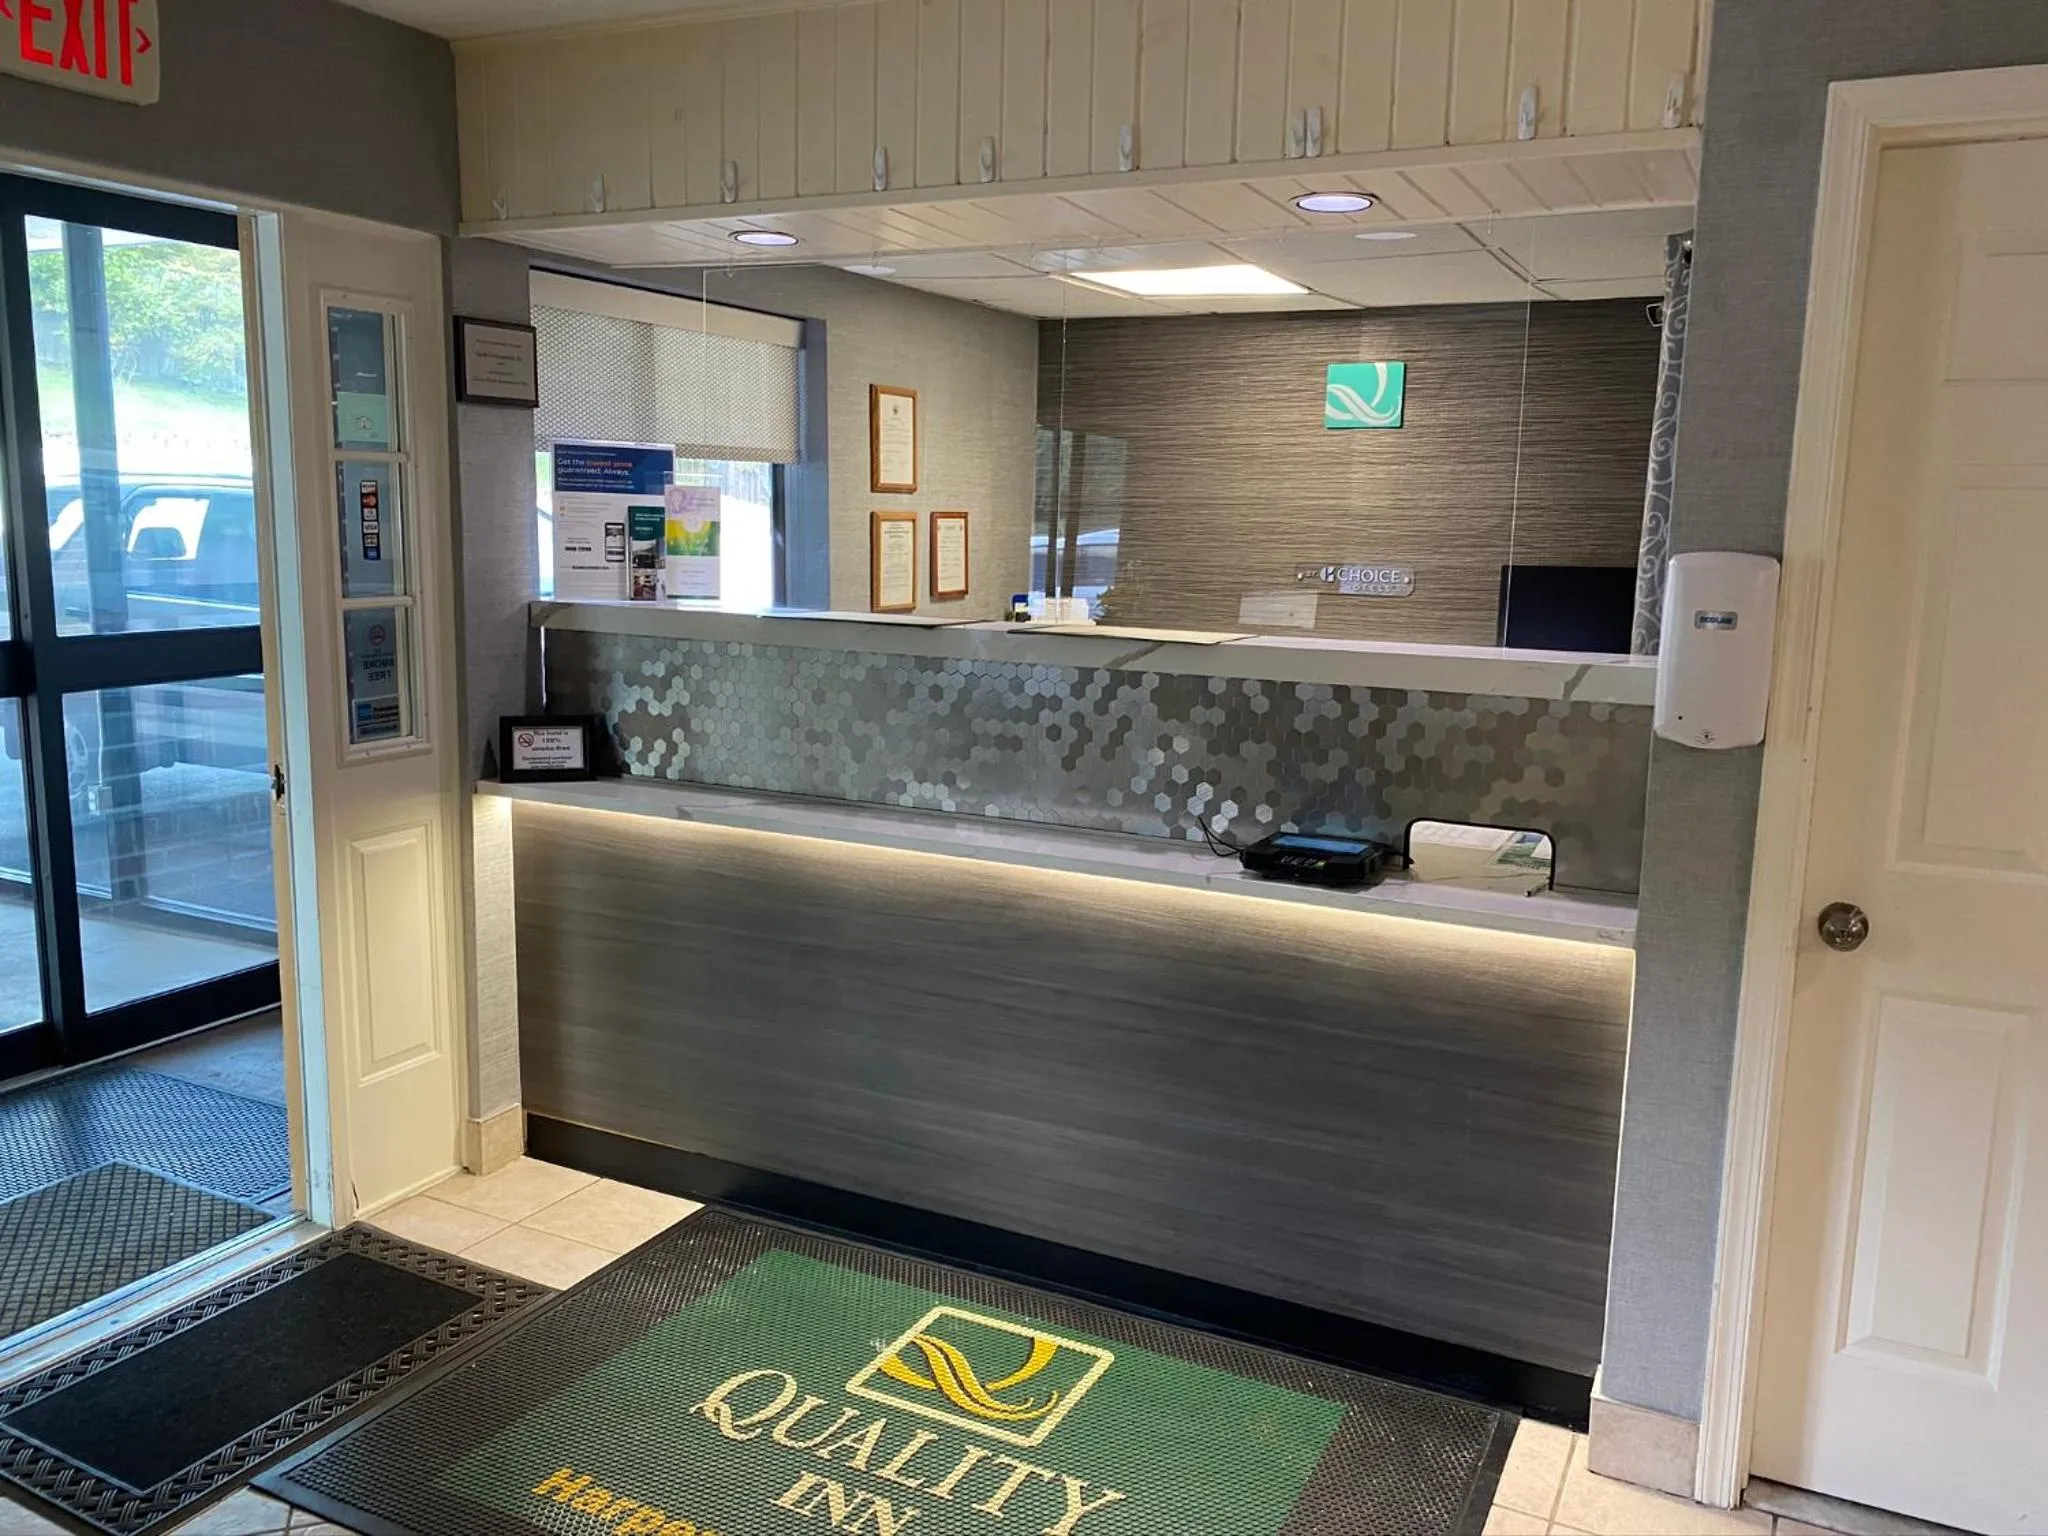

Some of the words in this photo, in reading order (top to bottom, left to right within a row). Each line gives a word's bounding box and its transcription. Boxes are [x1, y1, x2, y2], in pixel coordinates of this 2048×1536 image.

[20, 0, 138, 88] EXIT
[557, 458, 571, 466] Get
[572, 458, 585, 466] the
[1338, 567, 1401, 583] CHOICE
[690, 1369, 1127, 1536] QUALITY
[768, 1470, 922, 1536] INN
